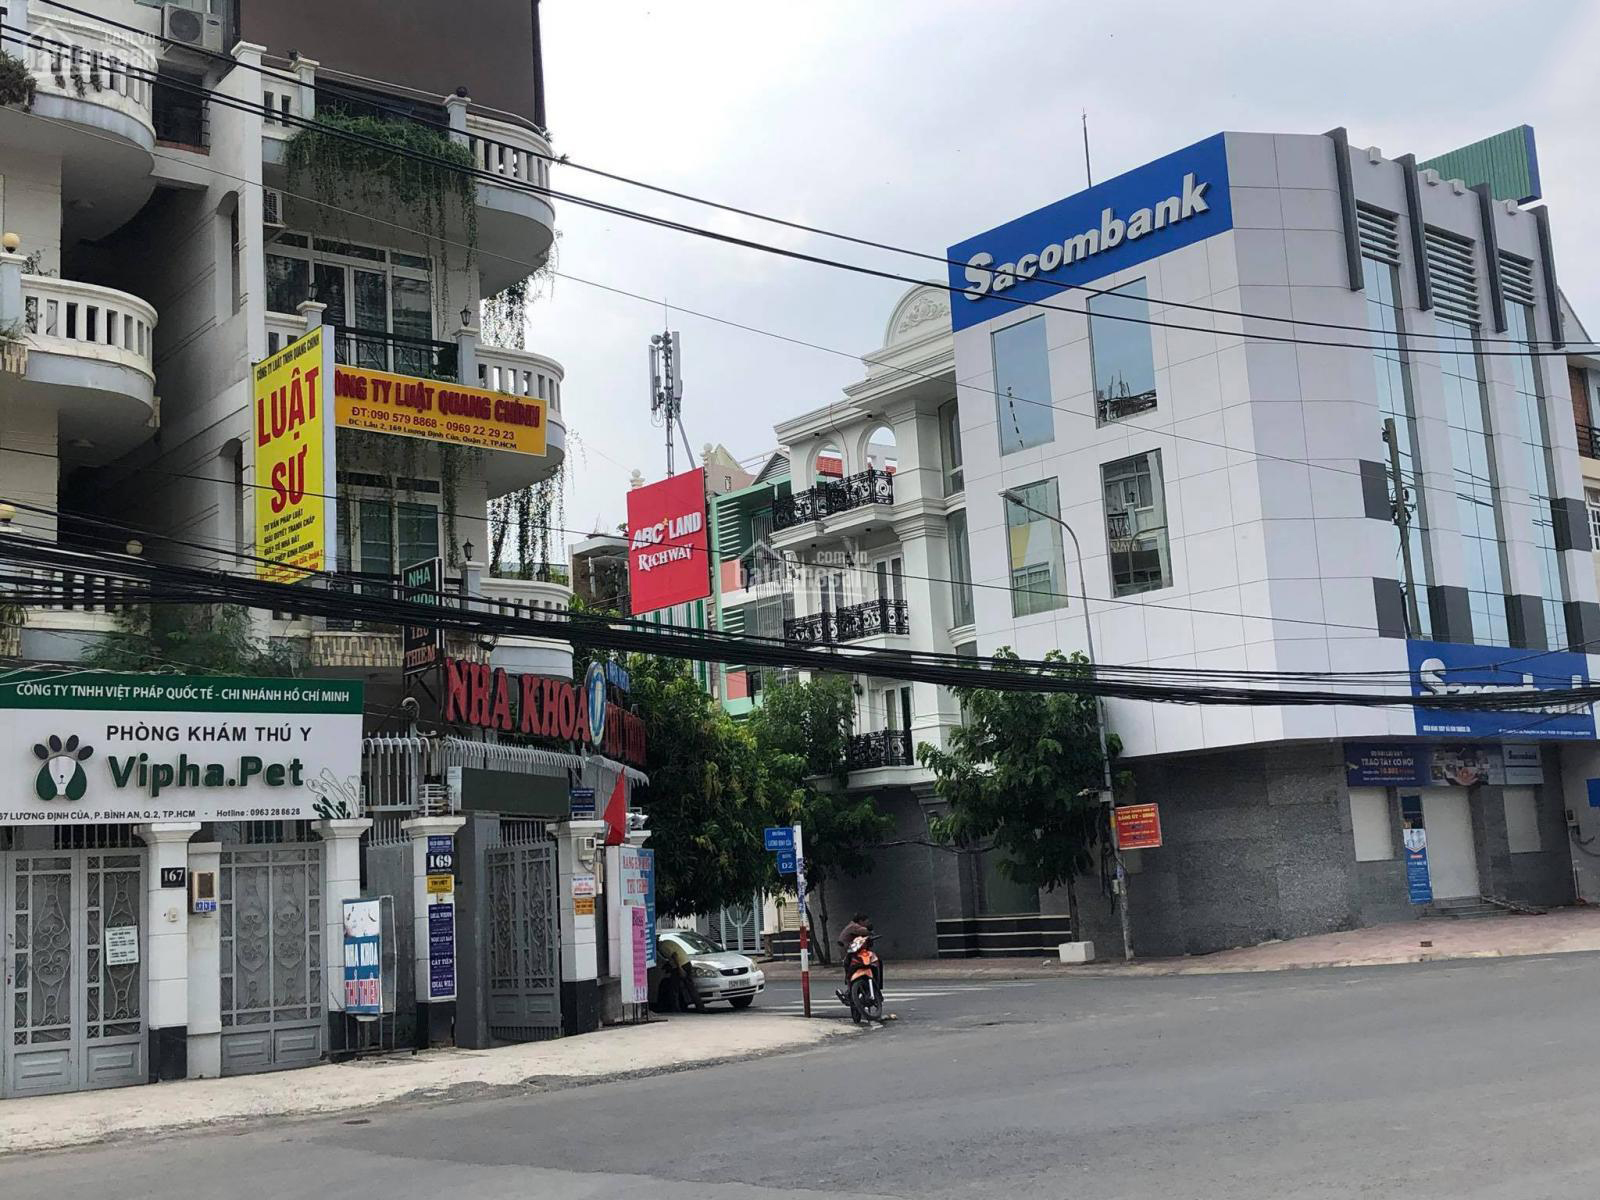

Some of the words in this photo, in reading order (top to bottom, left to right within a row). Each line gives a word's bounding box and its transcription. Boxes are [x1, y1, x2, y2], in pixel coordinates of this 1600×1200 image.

[964, 172, 1210, 301] Sacombank
[258, 367, 319, 448] LUẬT
[372, 379, 392, 403] TY
[395, 381, 435, 413] LUẬT
[438, 389, 491, 420] QUANG
[494, 398, 540, 428] CHÍNH
[388, 422, 402, 433] 169
[404, 425, 426, 437] Lương
[427, 428, 444, 440] Định
[462, 434, 481, 446] Quận
[490, 439, 517, 450] TP.HCM
[392, 412, 411, 424] 579
[413, 416, 438, 429] 8868
[446, 421, 471, 434] 0969
[473, 426, 486, 436] 22
[488, 428, 501, 438] 29
[502, 430, 515, 441] 23
[271, 443, 307, 513] SƯ
[631, 522, 665, 551] ABC
[668, 511, 702, 540] LAND
[408, 566, 431, 587] NHA
[16, 679, 51, 696] CÔNG
[53, 685, 67, 697] TY
[71, 685, 104, 697] TNHH
[105, 684, 131, 701] VIỆT
[133, 684, 164, 699] PHÁP
[166, 684, 199, 701] QUỐC
[200, 685, 214, 700] TẾ
[221, 688, 240, 700] CHI
[242, 687, 282, 701] NHÁNH
[284, 688, 300, 701] HỒ
[302, 688, 320, 702] CHÍ
[321, 691, 349, 702] MINH
[444, 656, 512, 730] NHA
[520, 673, 591, 742] KHOA
[106, 721, 180, 742] PHÒNG
[188, 722, 247, 742] KHÁM
[255, 722, 292, 742] THÚ
[300, 727, 312, 742] Y
[107, 752, 304, 798] Vipha.Pet
[10, 811, 46, 820] LƯƠNG
[47, 811, 69, 822] ĐỊNH
[94, 811, 103, 819] P.
[104, 809, 126, 819] BÌNH
[126, 810, 142, 820] AN,
[163, 810, 196, 819] TP.HCM
[250, 808, 269, 817] 0963
[271, 808, 280, 816] 28
[291, 808, 301, 816] 28
[164, 869, 184, 881] 167
[430, 854, 452, 868] 169
